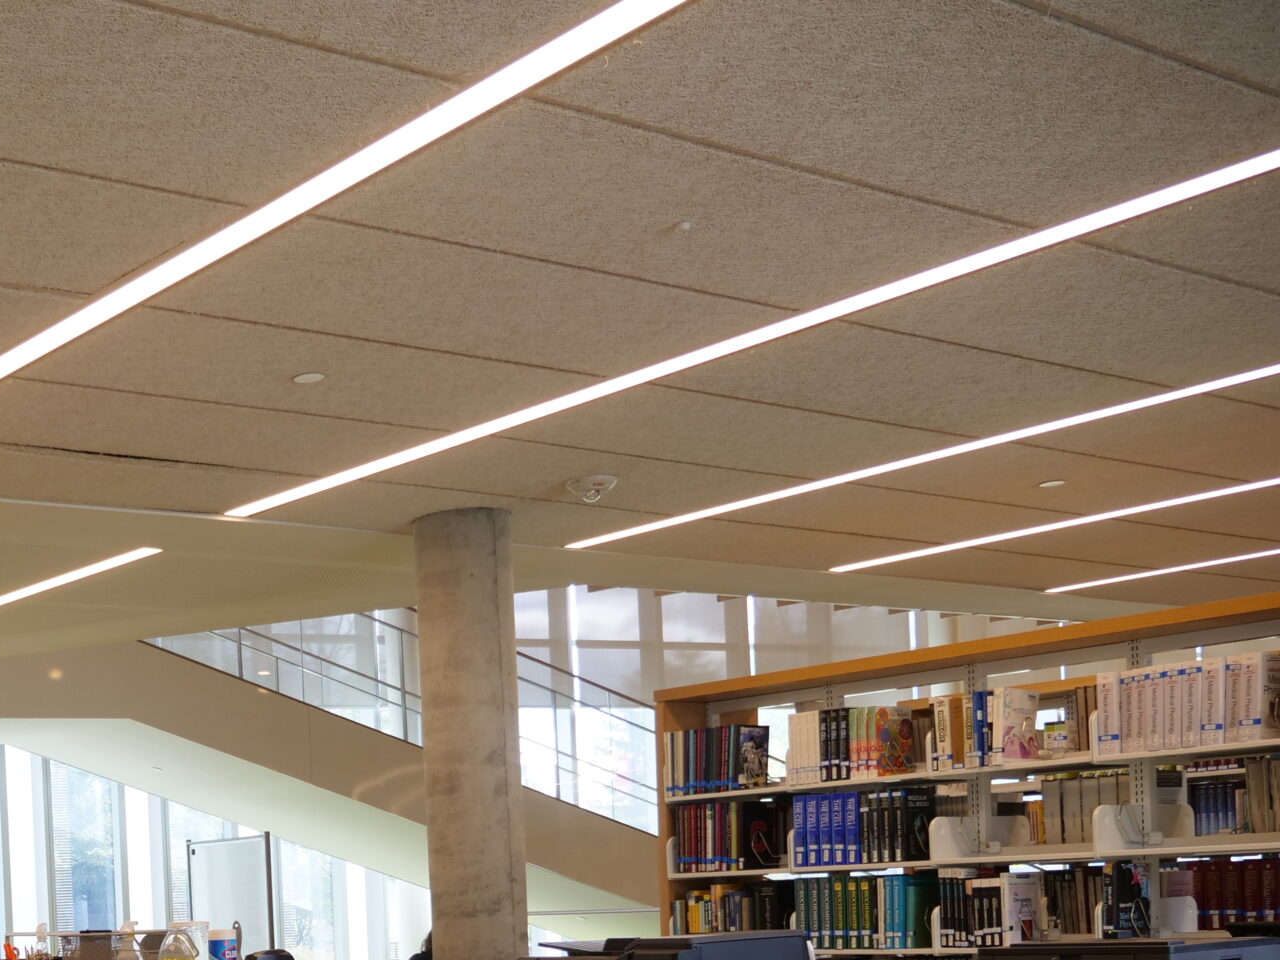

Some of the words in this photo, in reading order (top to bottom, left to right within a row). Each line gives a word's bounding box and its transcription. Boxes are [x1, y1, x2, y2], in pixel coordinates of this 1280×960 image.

[820, 800, 828, 812] THE
[807, 814, 815, 828] CELL
[820, 813, 828, 828] CELL
